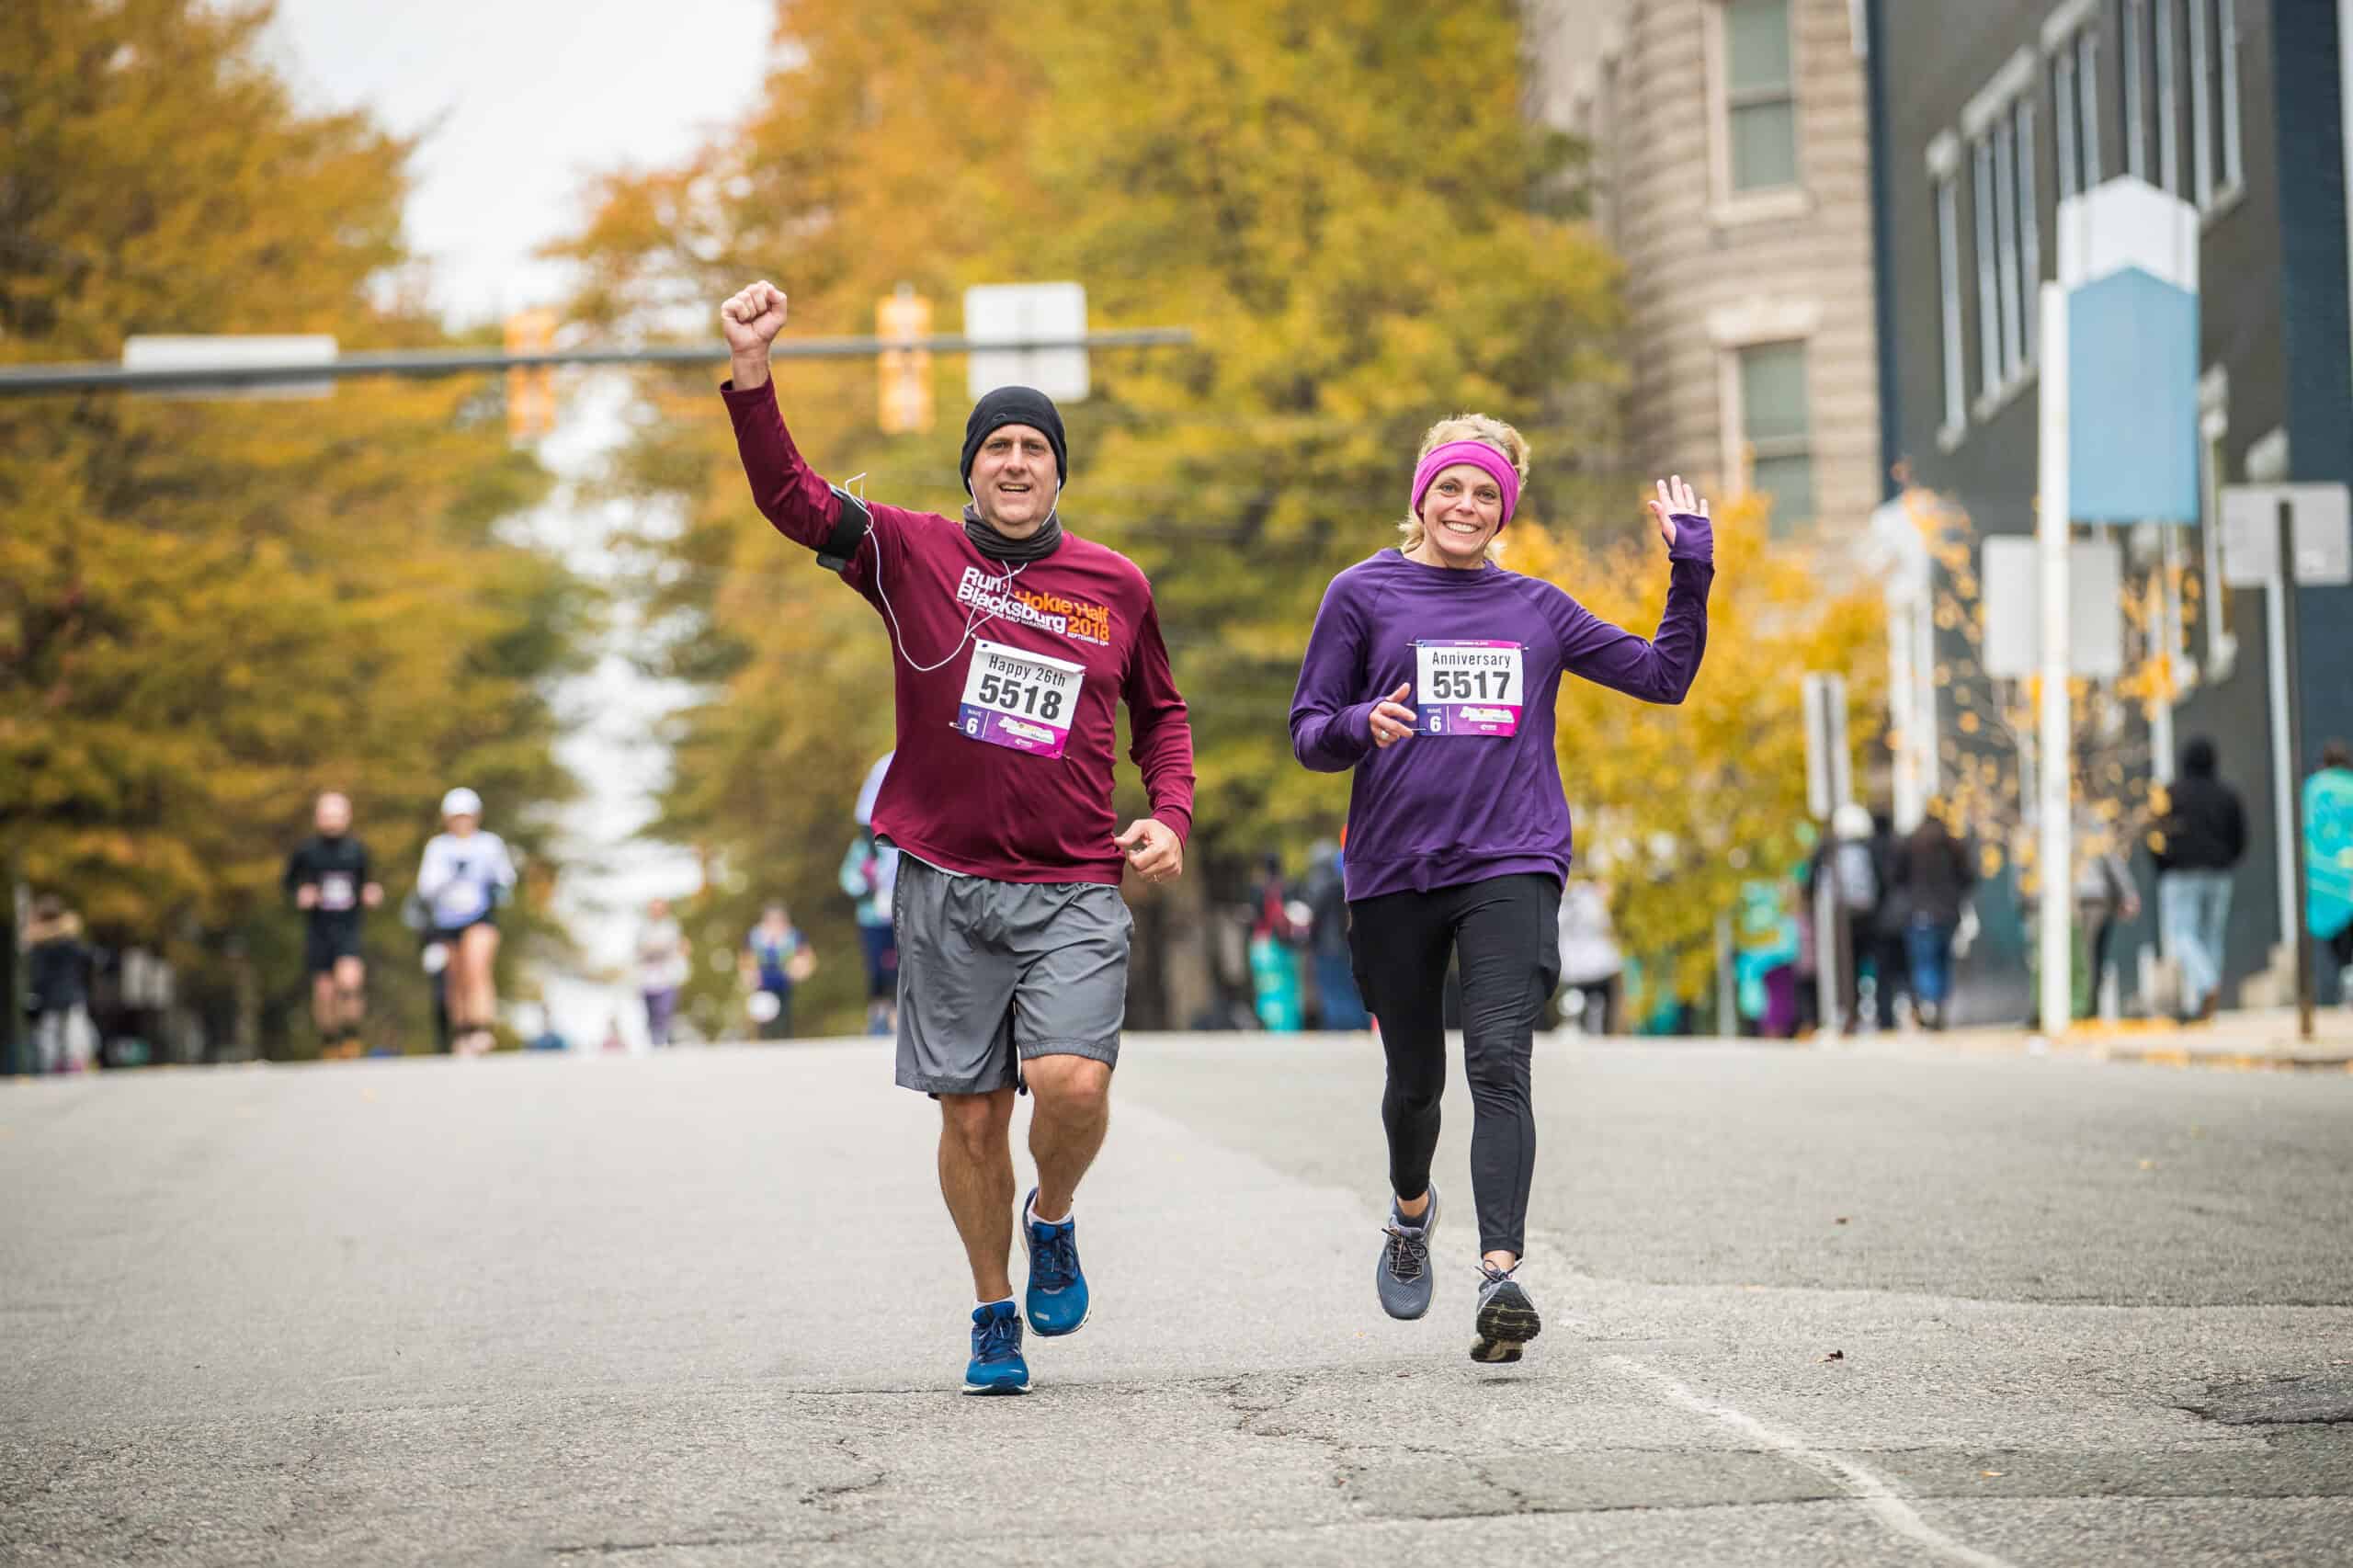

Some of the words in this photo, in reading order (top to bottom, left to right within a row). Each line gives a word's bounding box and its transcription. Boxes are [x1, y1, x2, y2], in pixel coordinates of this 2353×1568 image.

[962, 566, 1002, 593] Run
[957, 582, 1066, 634] Blacksburg
[1068, 616, 1110, 642] 2018
[1015, 590, 1073, 614] Hokie
[1074, 603, 1109, 624] Half
[988, 654, 1031, 680] Happy
[1035, 667, 1066, 687] 26th
[1432, 652, 1511, 668] Anniversary
[978, 674, 1063, 721] 5518
[1433, 670, 1511, 699] 5517
[966, 718, 979, 734] 6
[1429, 715, 1442, 733] 6
